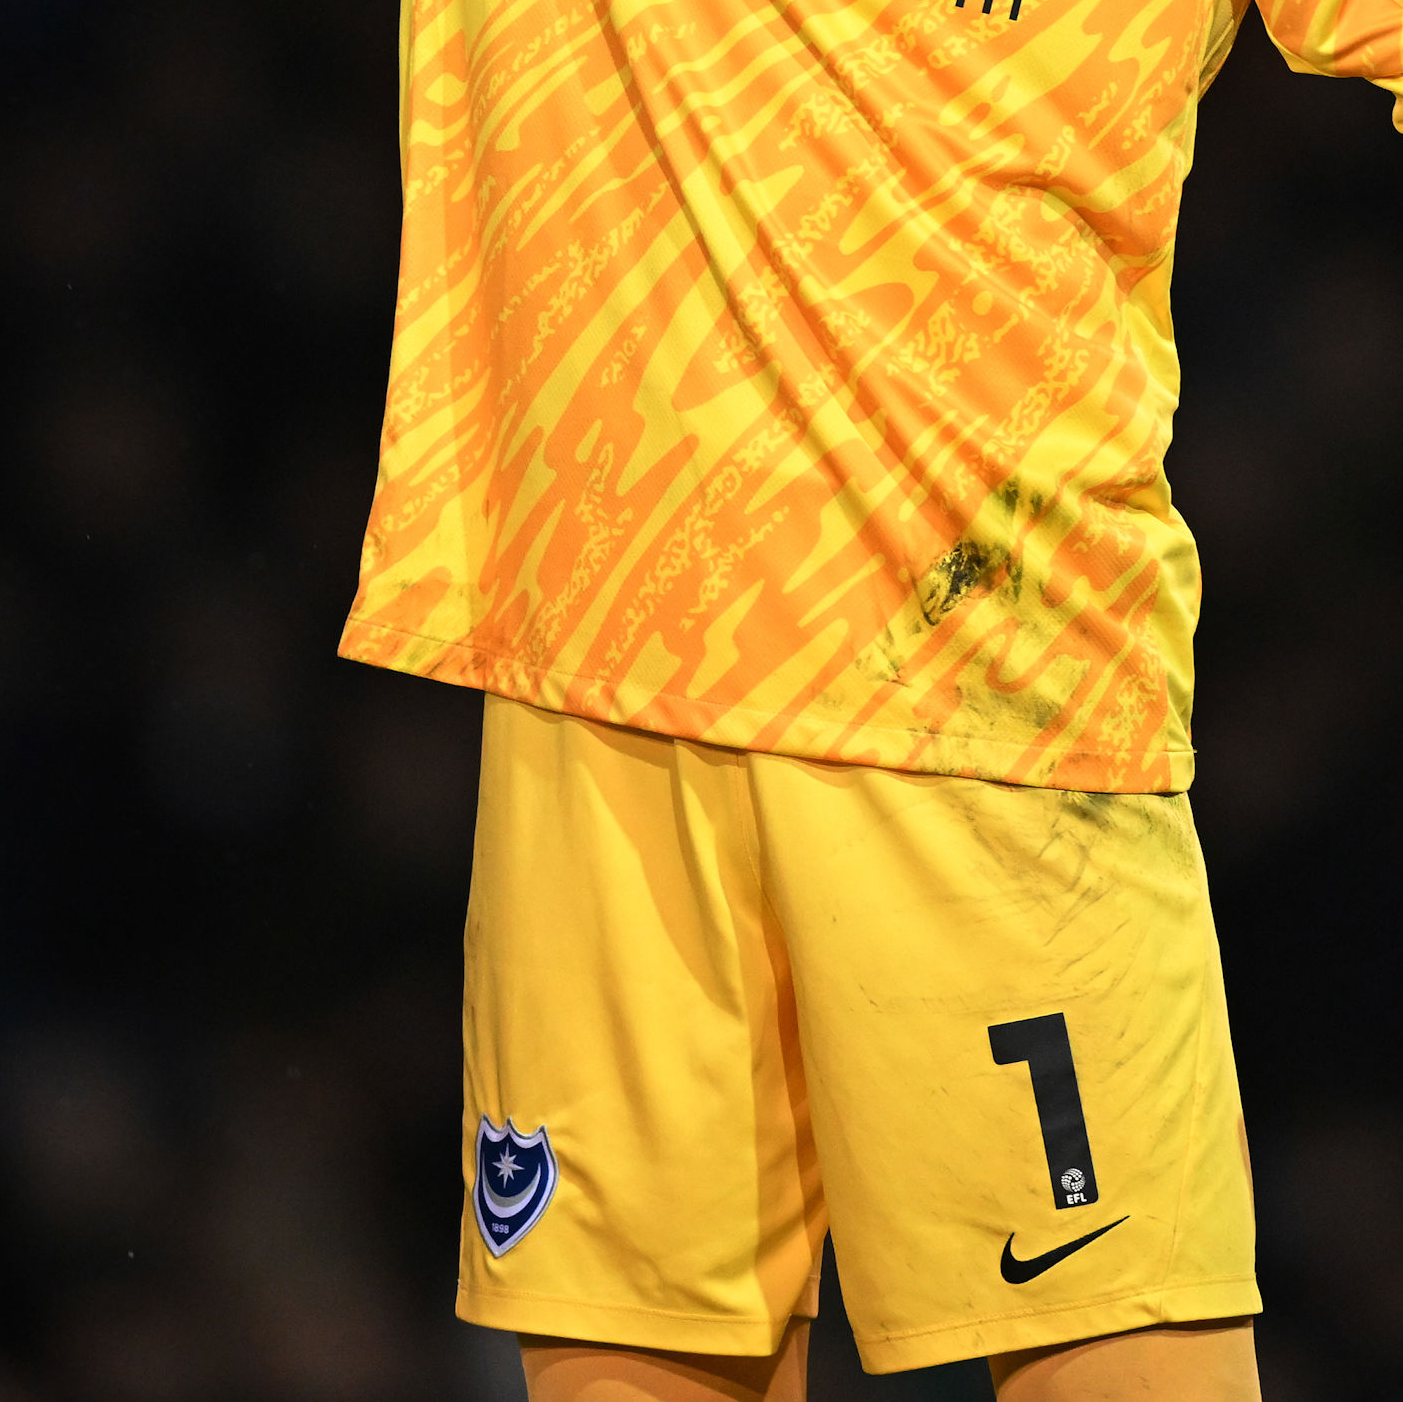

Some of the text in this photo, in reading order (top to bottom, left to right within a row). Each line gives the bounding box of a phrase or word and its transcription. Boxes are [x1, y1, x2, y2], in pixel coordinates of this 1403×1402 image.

[988, 1012, 1098, 1209] 1
[1066, 1192, 1088, 1205] EFL
[491, 1222, 510, 1234] 1898
